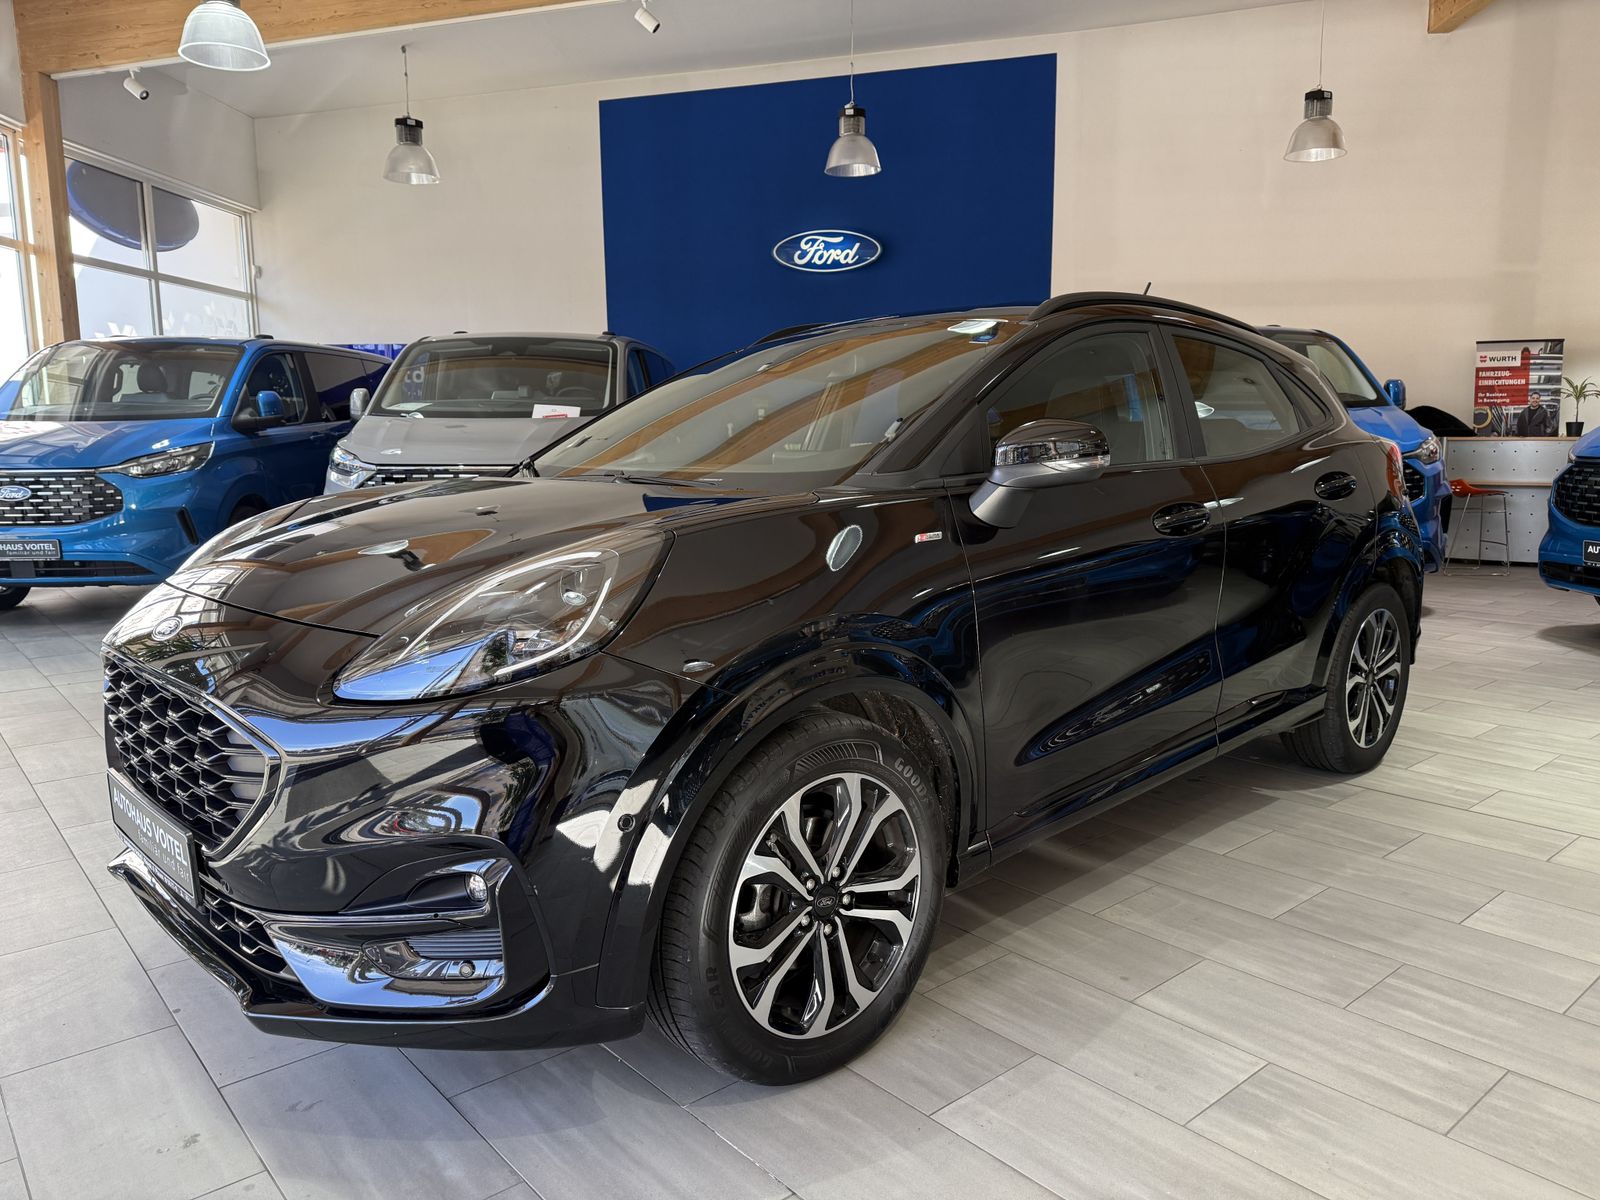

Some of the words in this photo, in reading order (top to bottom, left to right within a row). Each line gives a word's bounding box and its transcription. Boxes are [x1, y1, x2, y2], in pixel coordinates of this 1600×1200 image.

[794, 235, 860, 265] Ford
[24, 543, 56, 551] VOITEL
[113, 787, 153, 838] AUTOHAUS
[152, 821, 188, 867] VOITEL
